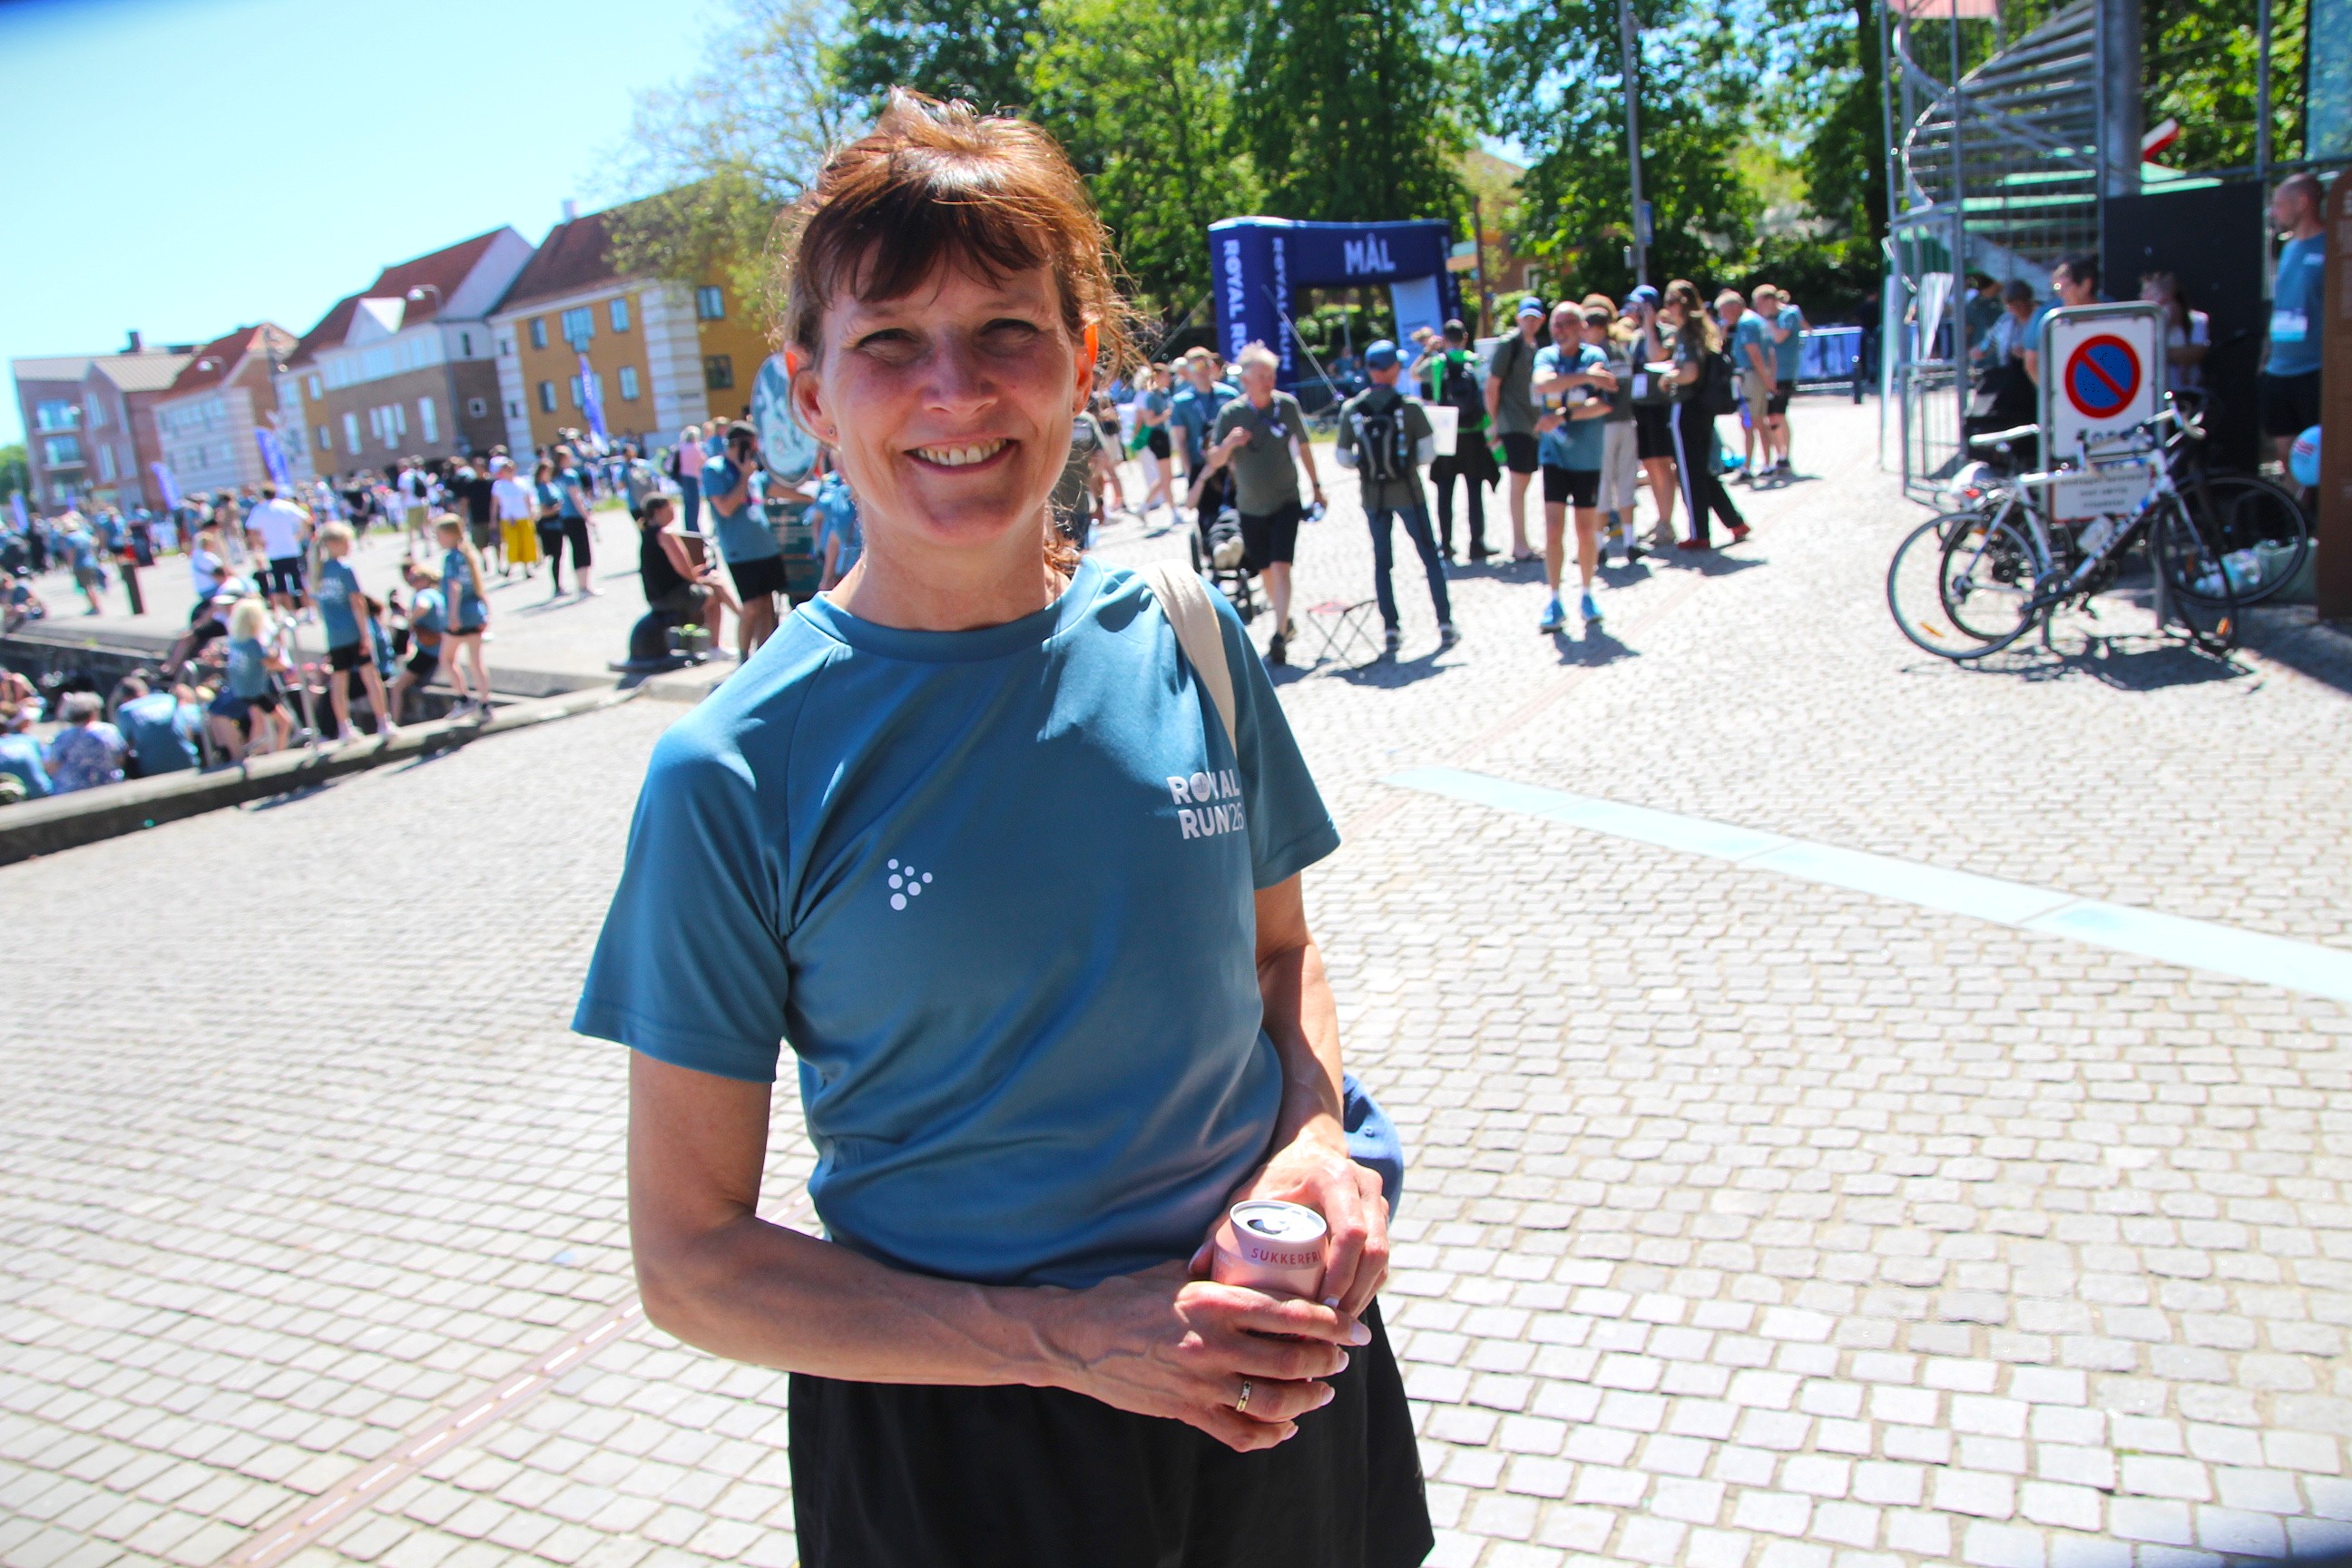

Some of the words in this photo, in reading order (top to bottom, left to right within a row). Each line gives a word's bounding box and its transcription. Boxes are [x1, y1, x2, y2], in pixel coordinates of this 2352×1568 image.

[1223, 239, 1245, 318] ROYAL
[1272, 237, 1289, 312] ROYAL
[1344, 232, 1396, 275] MÅL
[1166, 769, 1240, 806] ROYAL
